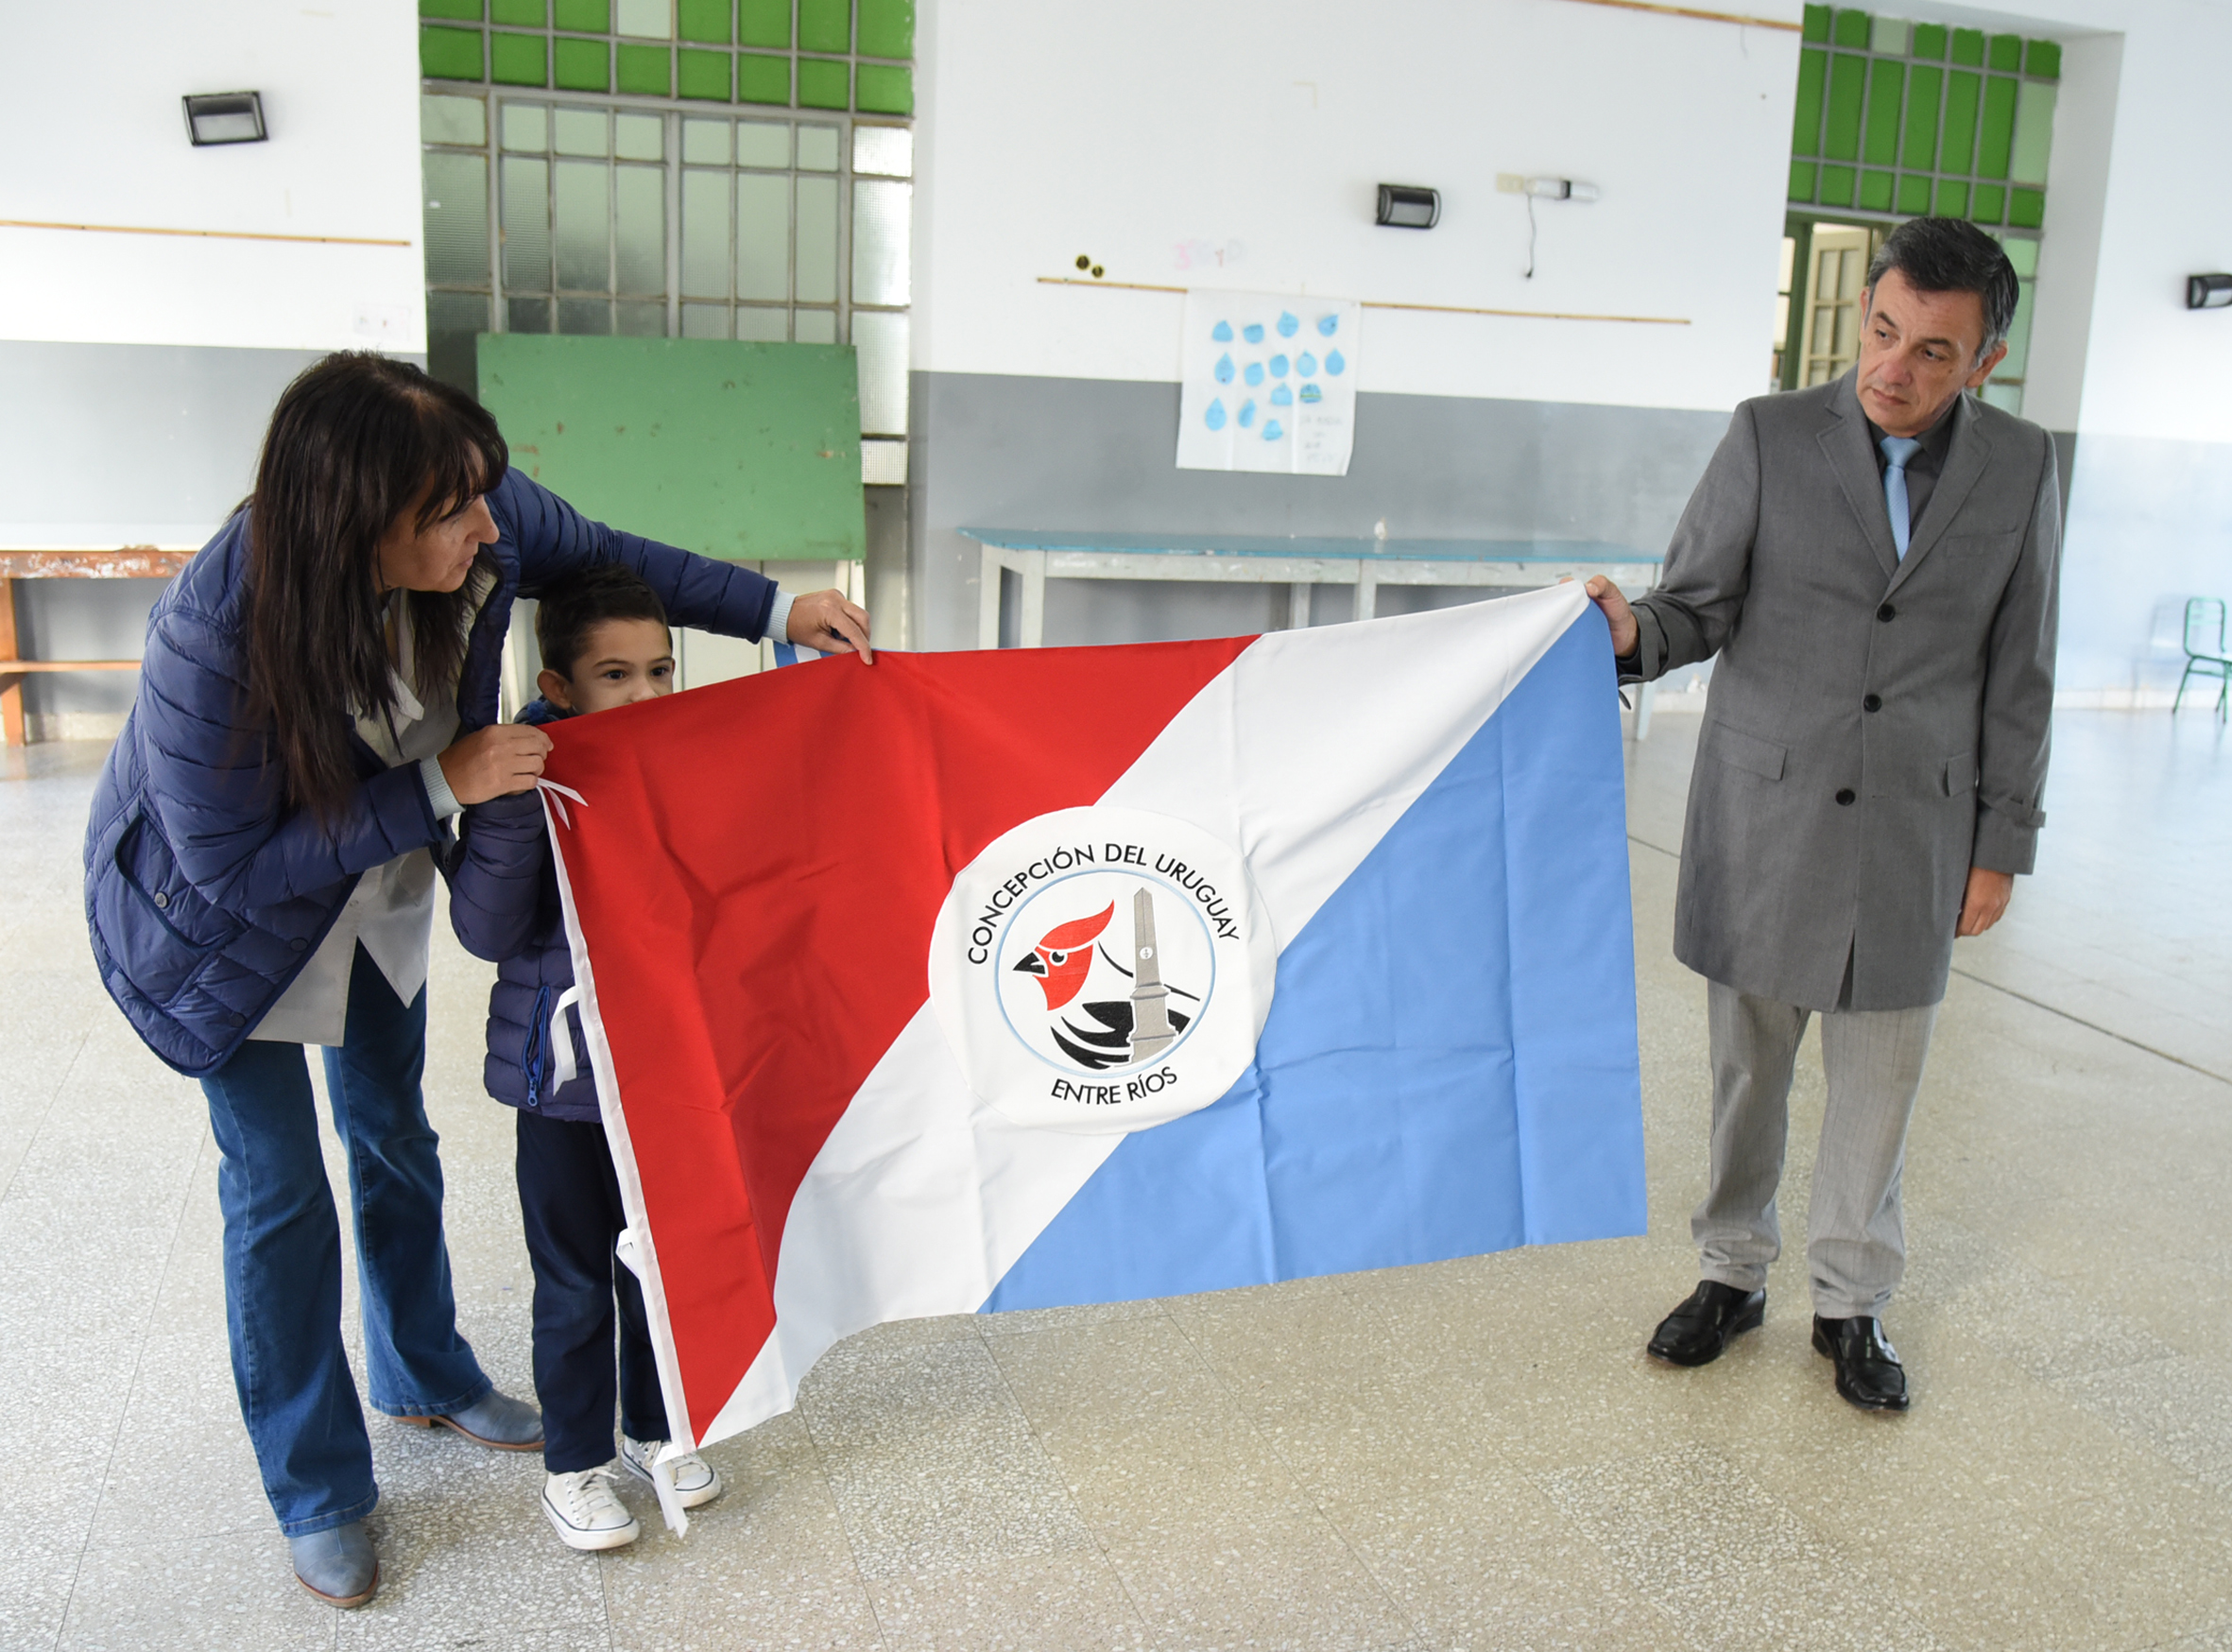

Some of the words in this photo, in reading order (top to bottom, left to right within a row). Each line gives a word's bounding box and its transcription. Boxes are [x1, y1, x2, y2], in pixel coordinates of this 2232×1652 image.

[968, 845, 1095, 965] CONCEPCIÓN
[1105, 843, 1147, 867] DEL
[1155, 853, 1240, 940] URUGUAY
[1051, 1078, 1122, 1105] ENTRE
[1128, 1066, 1177, 1102] RÍOS
